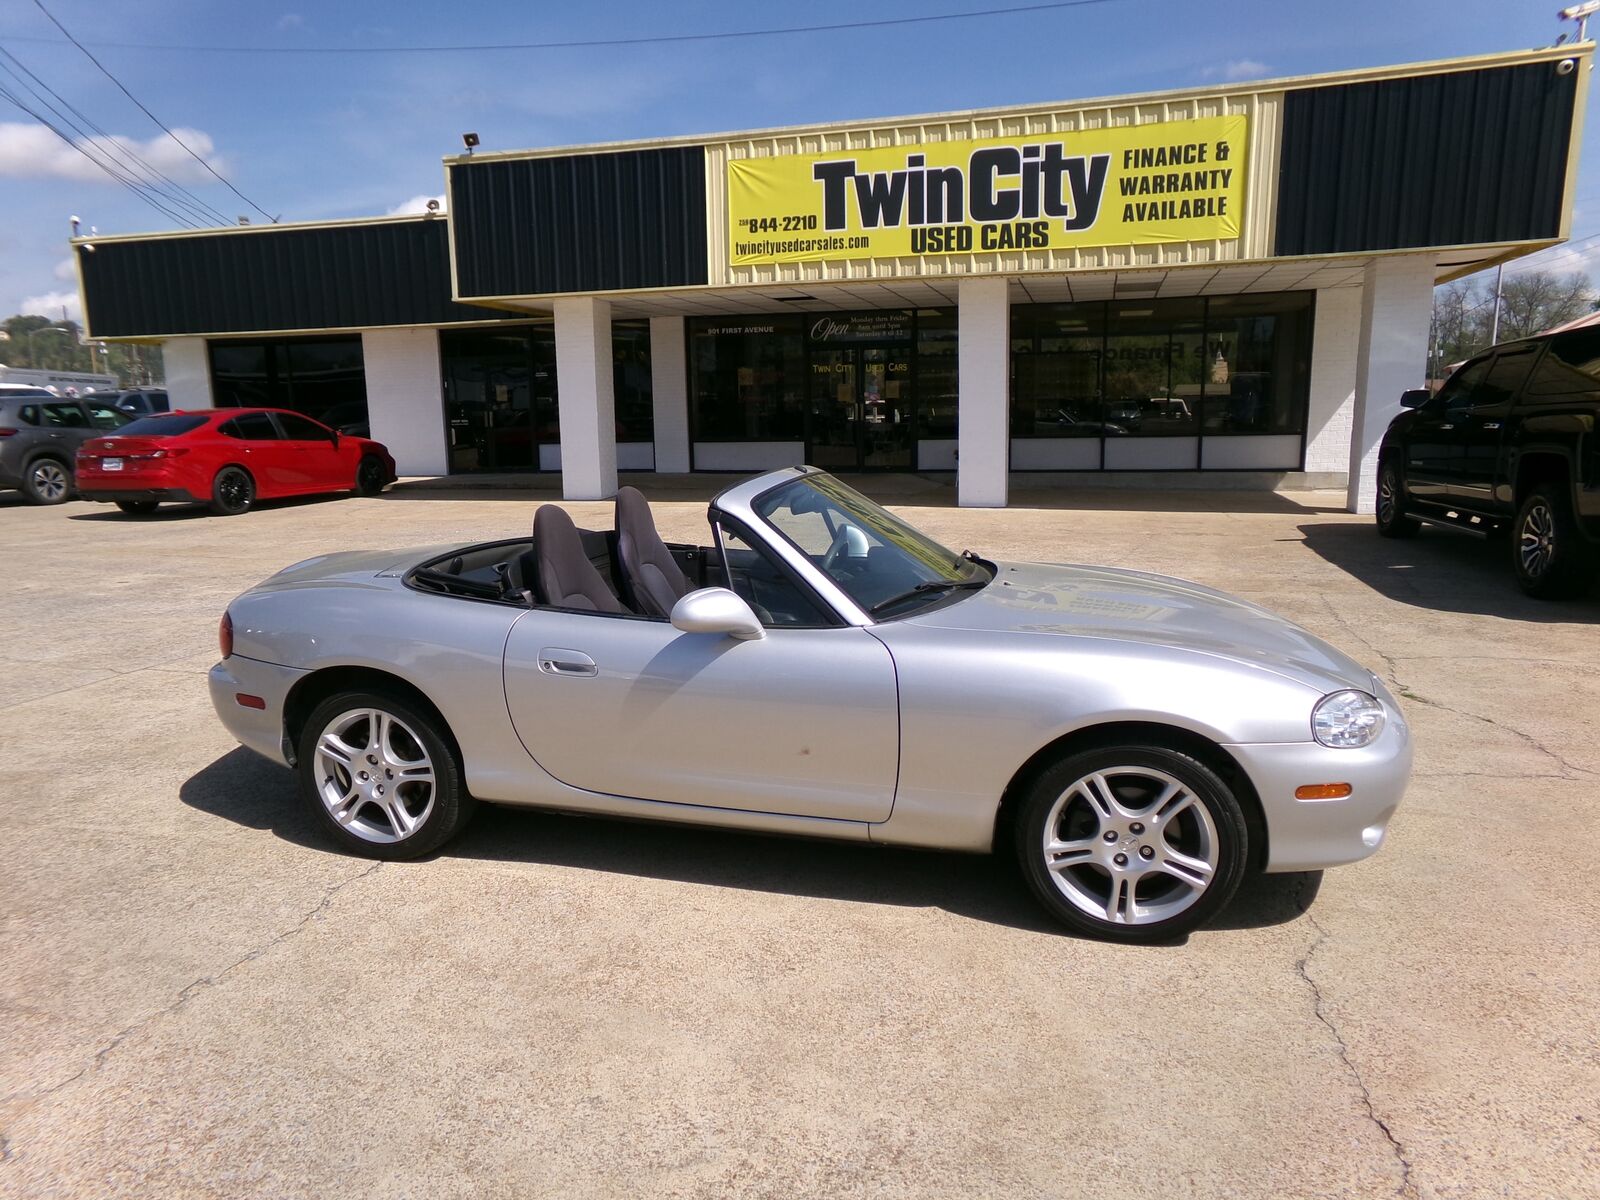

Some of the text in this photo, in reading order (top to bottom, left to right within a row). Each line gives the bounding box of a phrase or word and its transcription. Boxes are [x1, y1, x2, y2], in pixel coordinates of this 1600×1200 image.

[1123, 140, 1230, 170] FINANCE &
[1119, 169, 1233, 196] WARRANTY
[1122, 196, 1227, 223] AVAILABLE
[749, 214, 817, 234] 844-2210
[735, 236, 869, 256] twincityusedcarsales.com
[911, 221, 1049, 253] USED CARS
[744, 325, 774, 334] AVENUE
[810, 317, 849, 341] Open
[813, 363, 908, 373] TWIN CITY USED CARS
